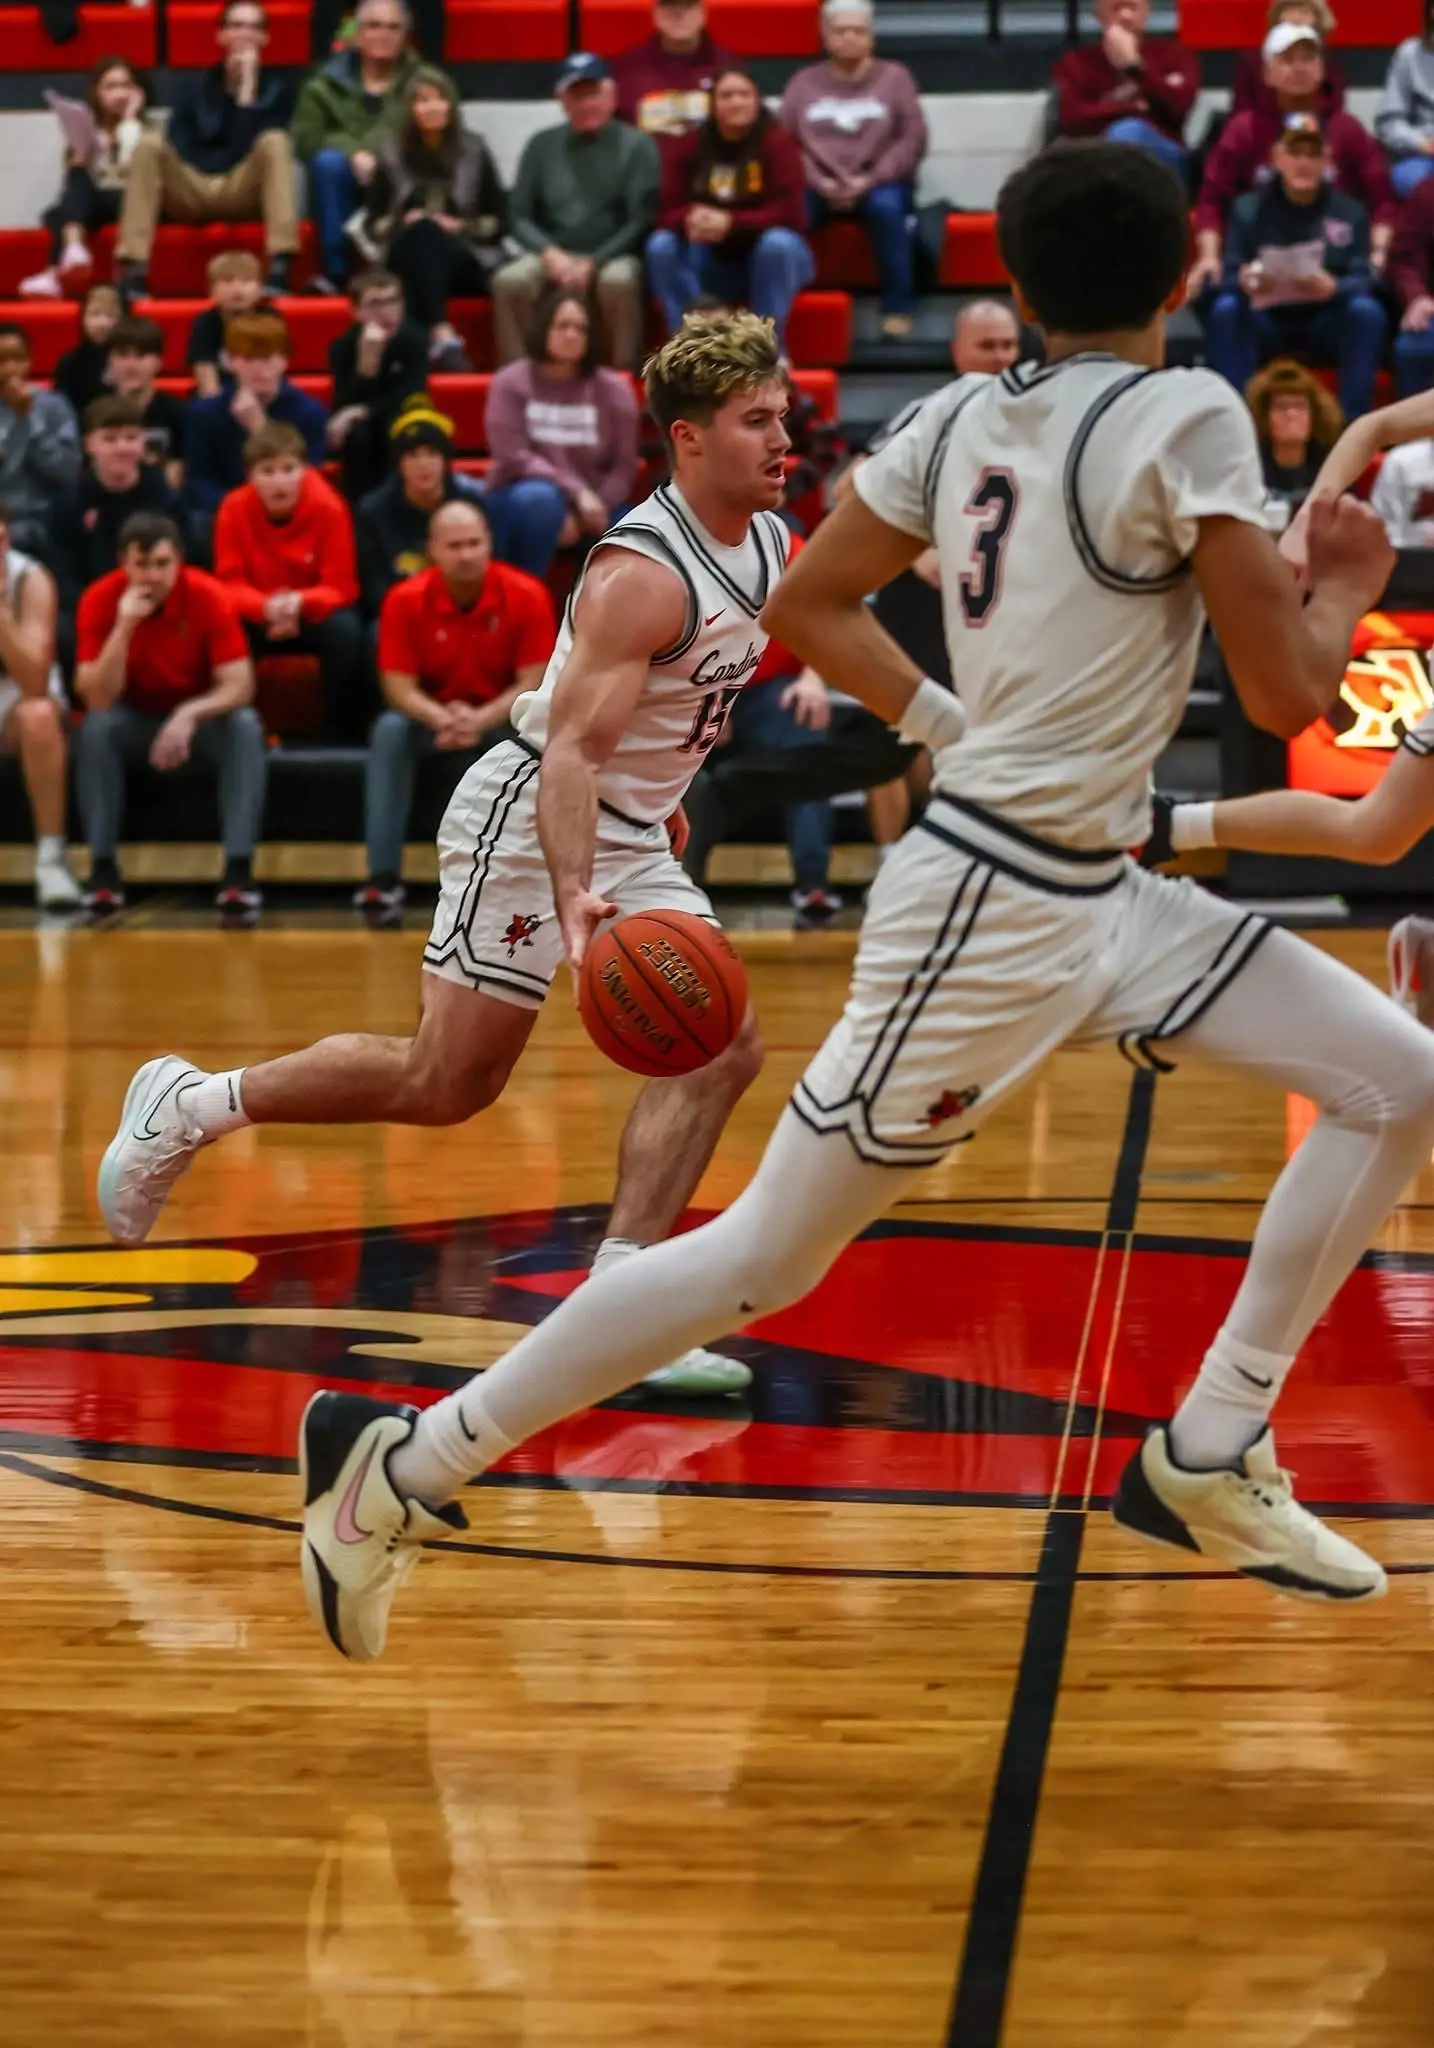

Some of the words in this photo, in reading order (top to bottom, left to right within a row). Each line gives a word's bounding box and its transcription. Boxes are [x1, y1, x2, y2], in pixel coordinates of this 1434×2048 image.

[957, 465, 1022, 629] 3
[600, 955, 680, 1056] SPALDING
[636, 941, 707, 1023] LEGACY
